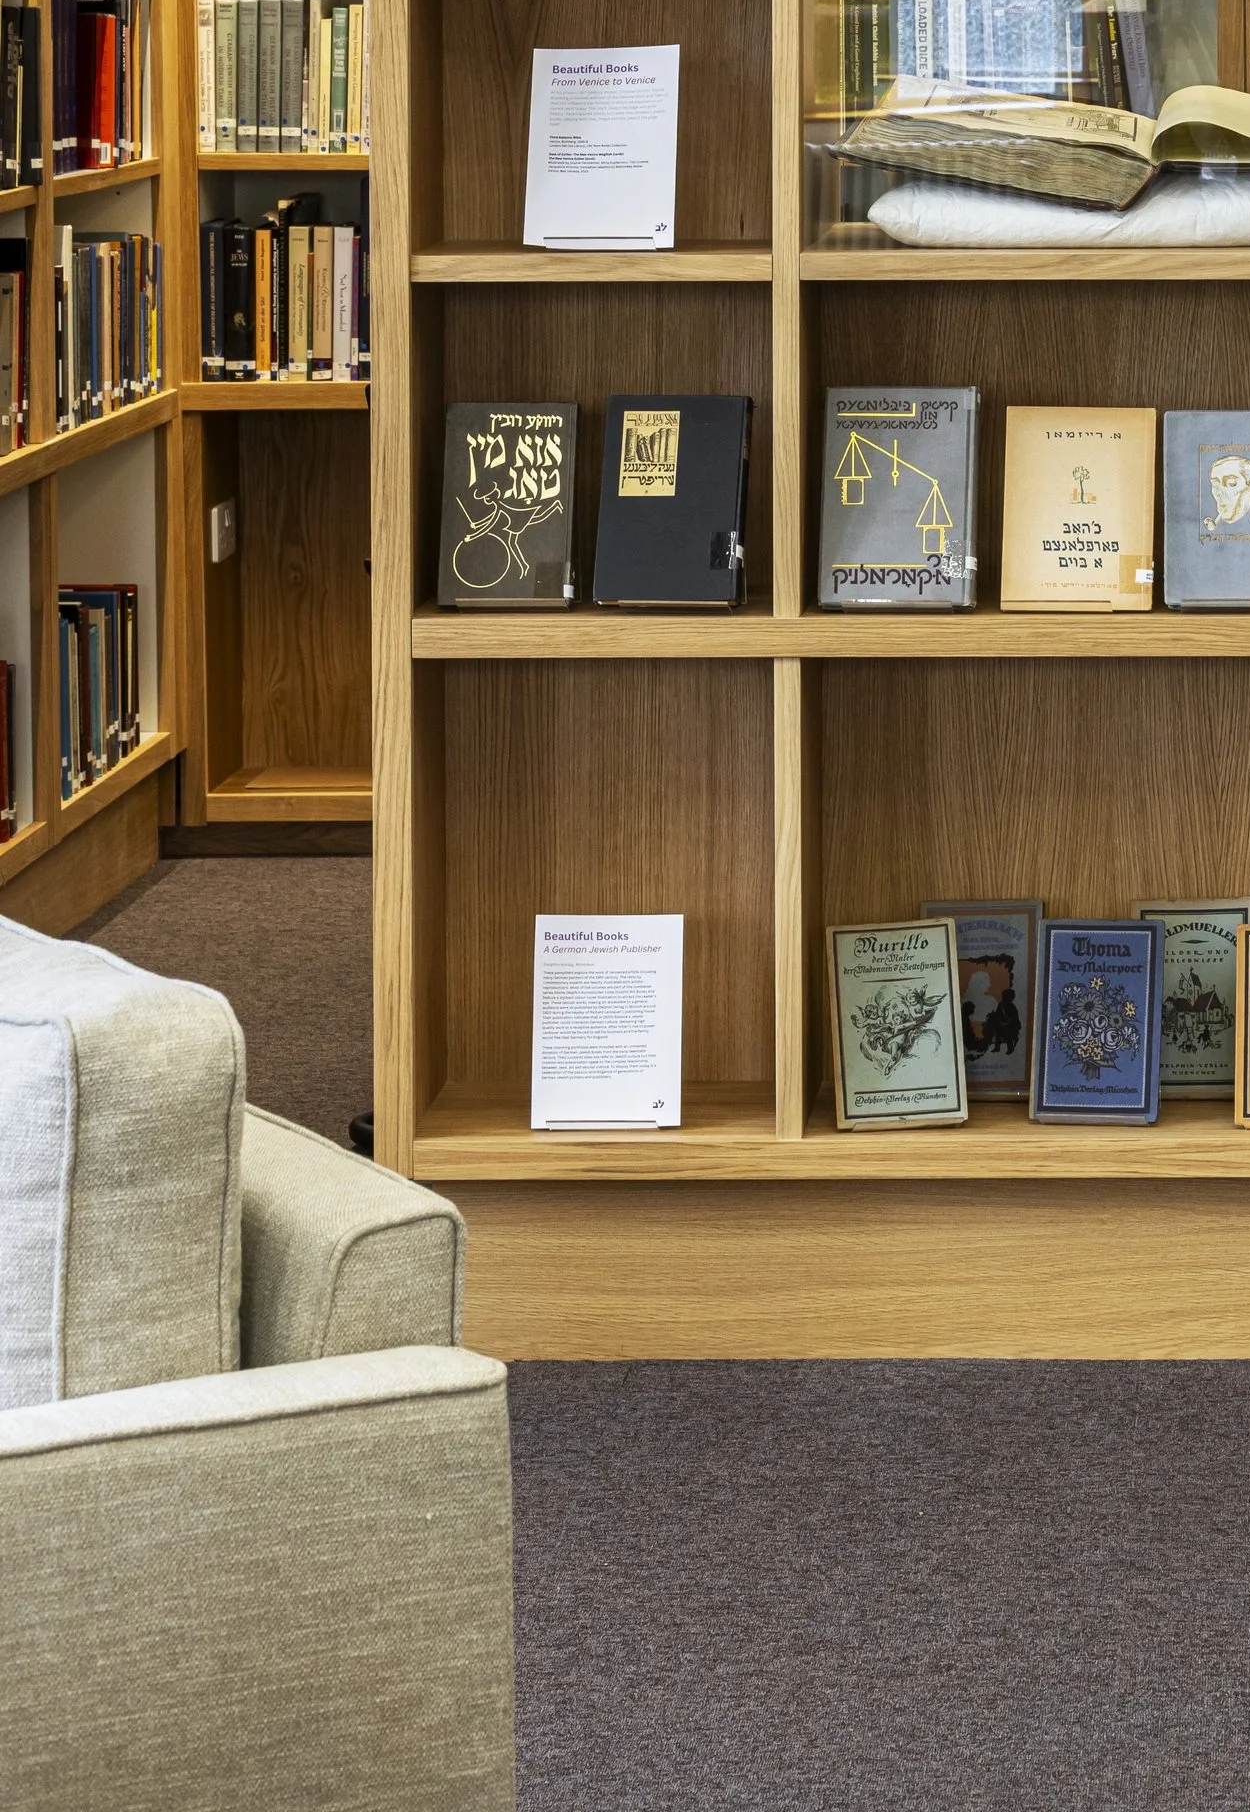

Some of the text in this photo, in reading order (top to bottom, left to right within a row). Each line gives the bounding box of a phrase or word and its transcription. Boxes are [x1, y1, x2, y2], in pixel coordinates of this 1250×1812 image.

[918, 0, 928, 70] LOADED DICE
[552, 63, 639, 74] Beautiful Books
[551, 76, 656, 87] From Venice to Venice
[466, 433, 506, 488] מין
[1093, 557, 1103, 568] א
[544, 931, 629, 941] Beautiful Books
[543, 945, 661, 954] A German Jewish Publisher
[854, 932, 929, 958] Murillo
[1071, 935, 1132, 961] Thoma
[871, 953, 915, 966] der Maler
[843, 966, 854, 975] der
[853, 964, 892, 978] Madonnen
[1056, 960, 1083, 973] Der
